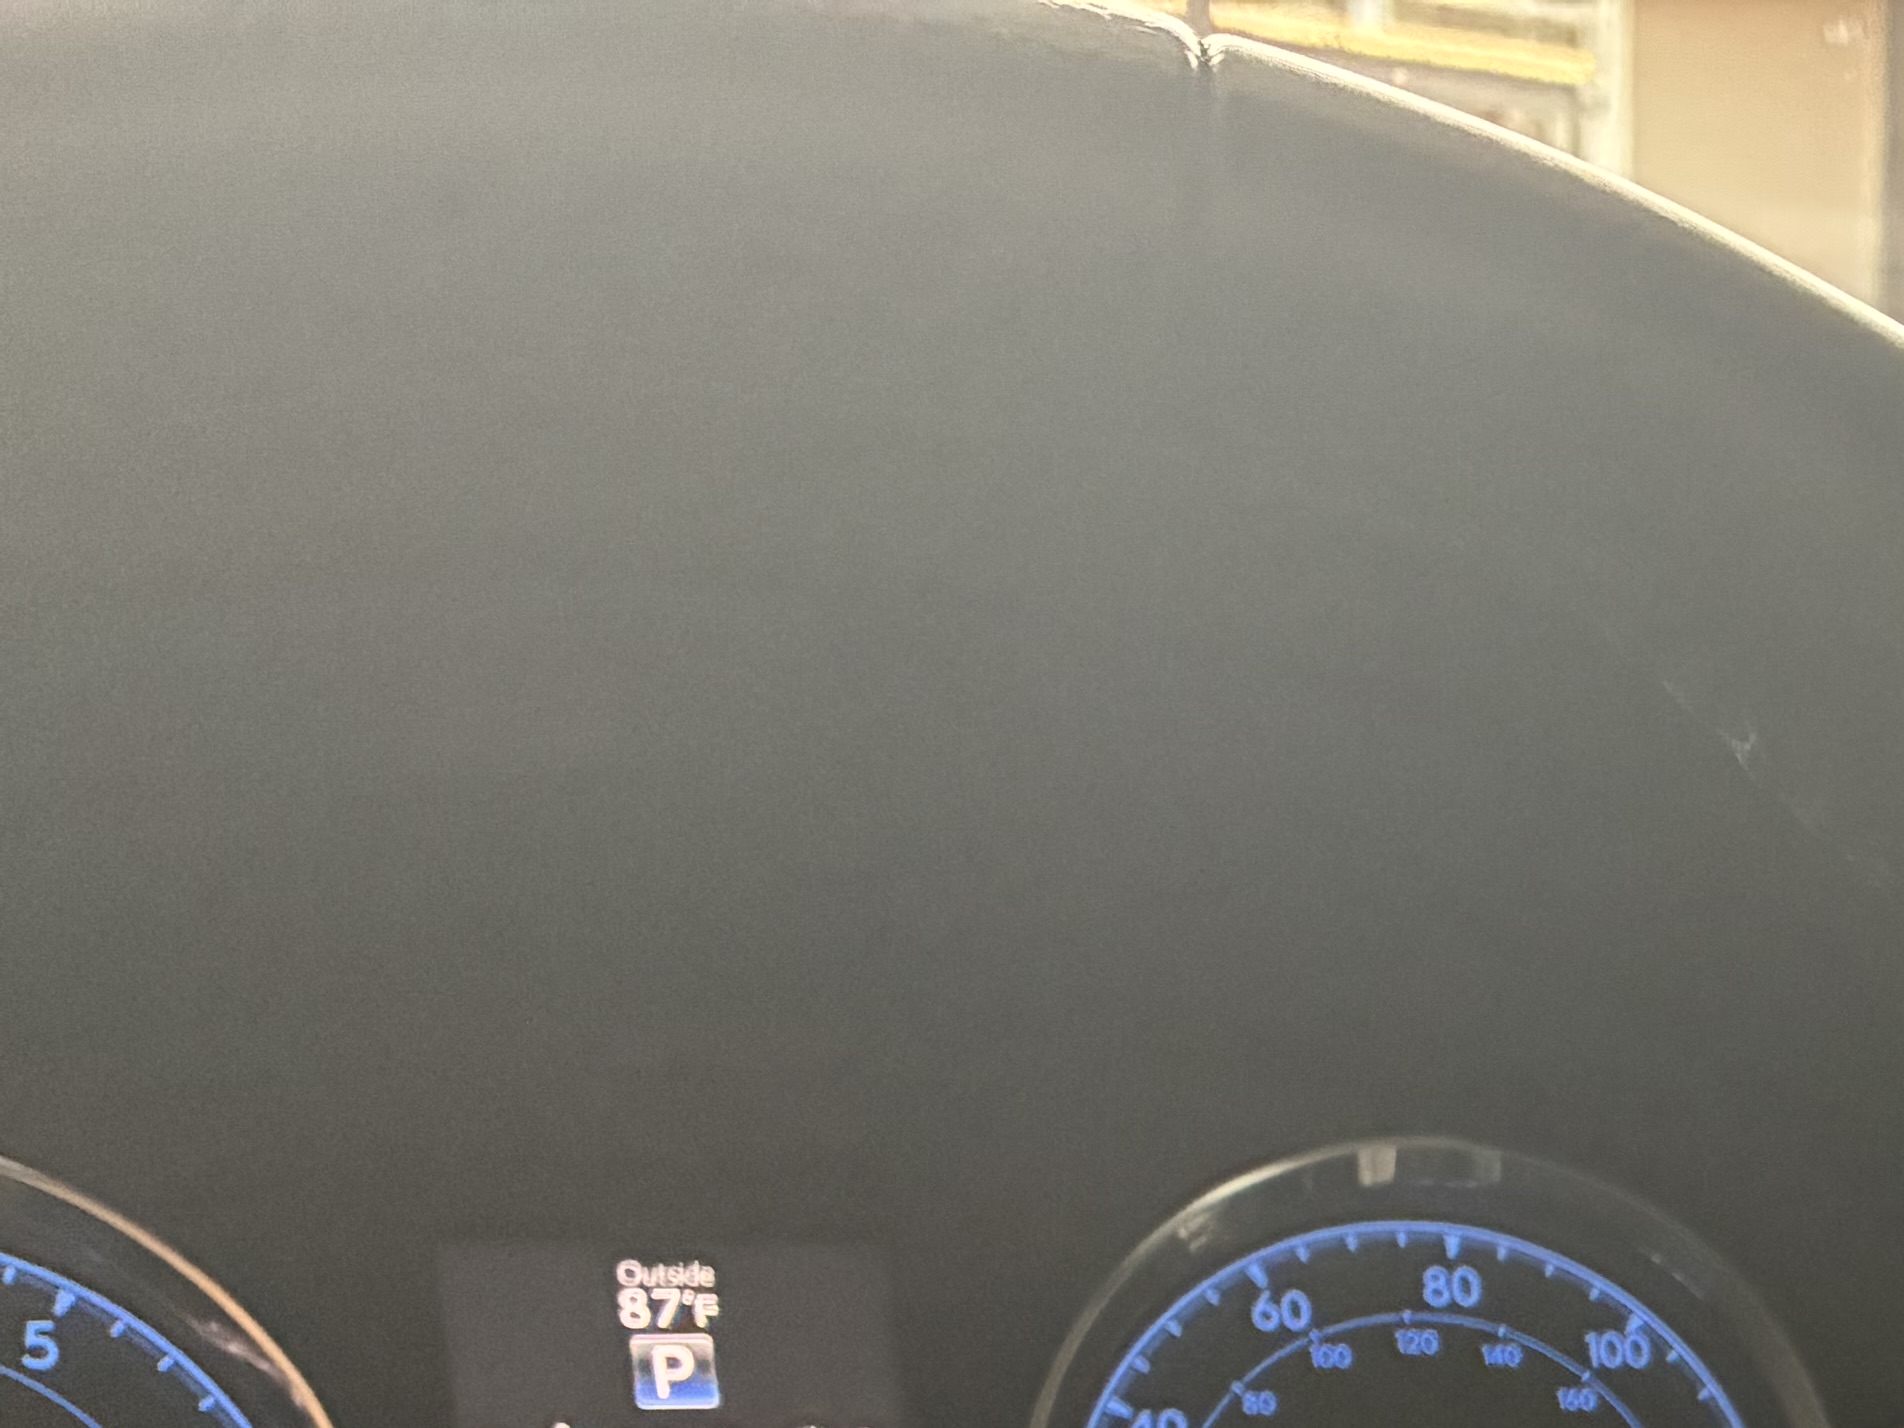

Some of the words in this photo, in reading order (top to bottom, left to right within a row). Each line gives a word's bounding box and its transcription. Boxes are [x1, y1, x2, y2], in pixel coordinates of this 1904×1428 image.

[615, 1259, 716, 1287] Outside
[1423, 1265, 1483, 1308] 80
[1251, 1289, 1312, 1333] 60
[21, 1320, 60, 1371] 5
[1309, 1343, 1353, 1369] 100
[1394, 1328, 1440, 1356] 120
[1482, 1343, 1524, 1369] 140
[1584, 1330, 1651, 1370] 100
[651, 1344, 695, 1400] P
[1242, 1390, 1278, 1416] 80
